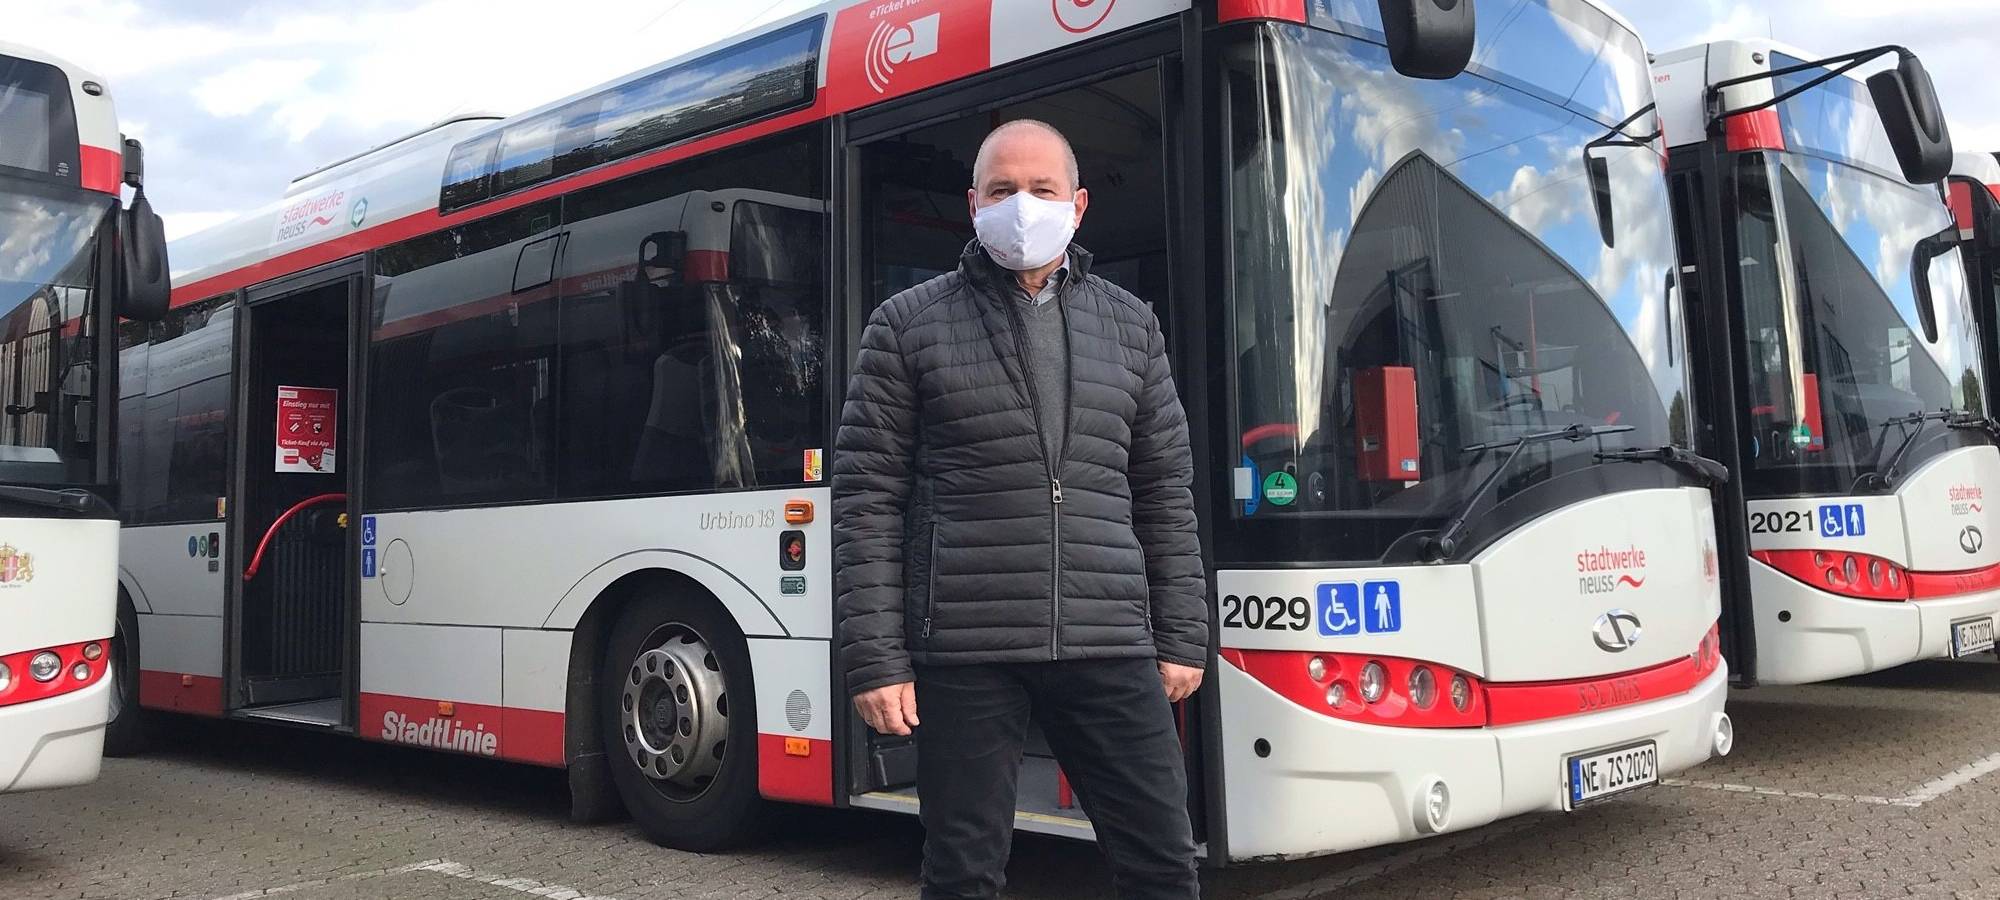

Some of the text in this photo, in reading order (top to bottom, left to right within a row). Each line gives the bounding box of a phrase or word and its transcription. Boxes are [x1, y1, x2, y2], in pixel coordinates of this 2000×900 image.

[869, 0, 903, 19] eTicket
[280, 189, 344, 224] stadtwerke
[277, 220, 307, 241] neuss
[282, 400, 308, 409] Einstieg
[1274, 472, 1286, 489] 4
[1949, 483, 1983, 501] stadtwerke
[699, 509, 775, 530] Urbino 18
[1951, 503, 1969, 515] neuss
[1750, 509, 1814, 534] 2021
[1577, 544, 1646, 572] stadtwerke
[1579, 574, 1615, 595] neuss
[1222, 594, 1312, 631] 2029
[381, 710, 498, 756] StadtLinie
[1581, 748, 1654, 794] NE ZS 2029
